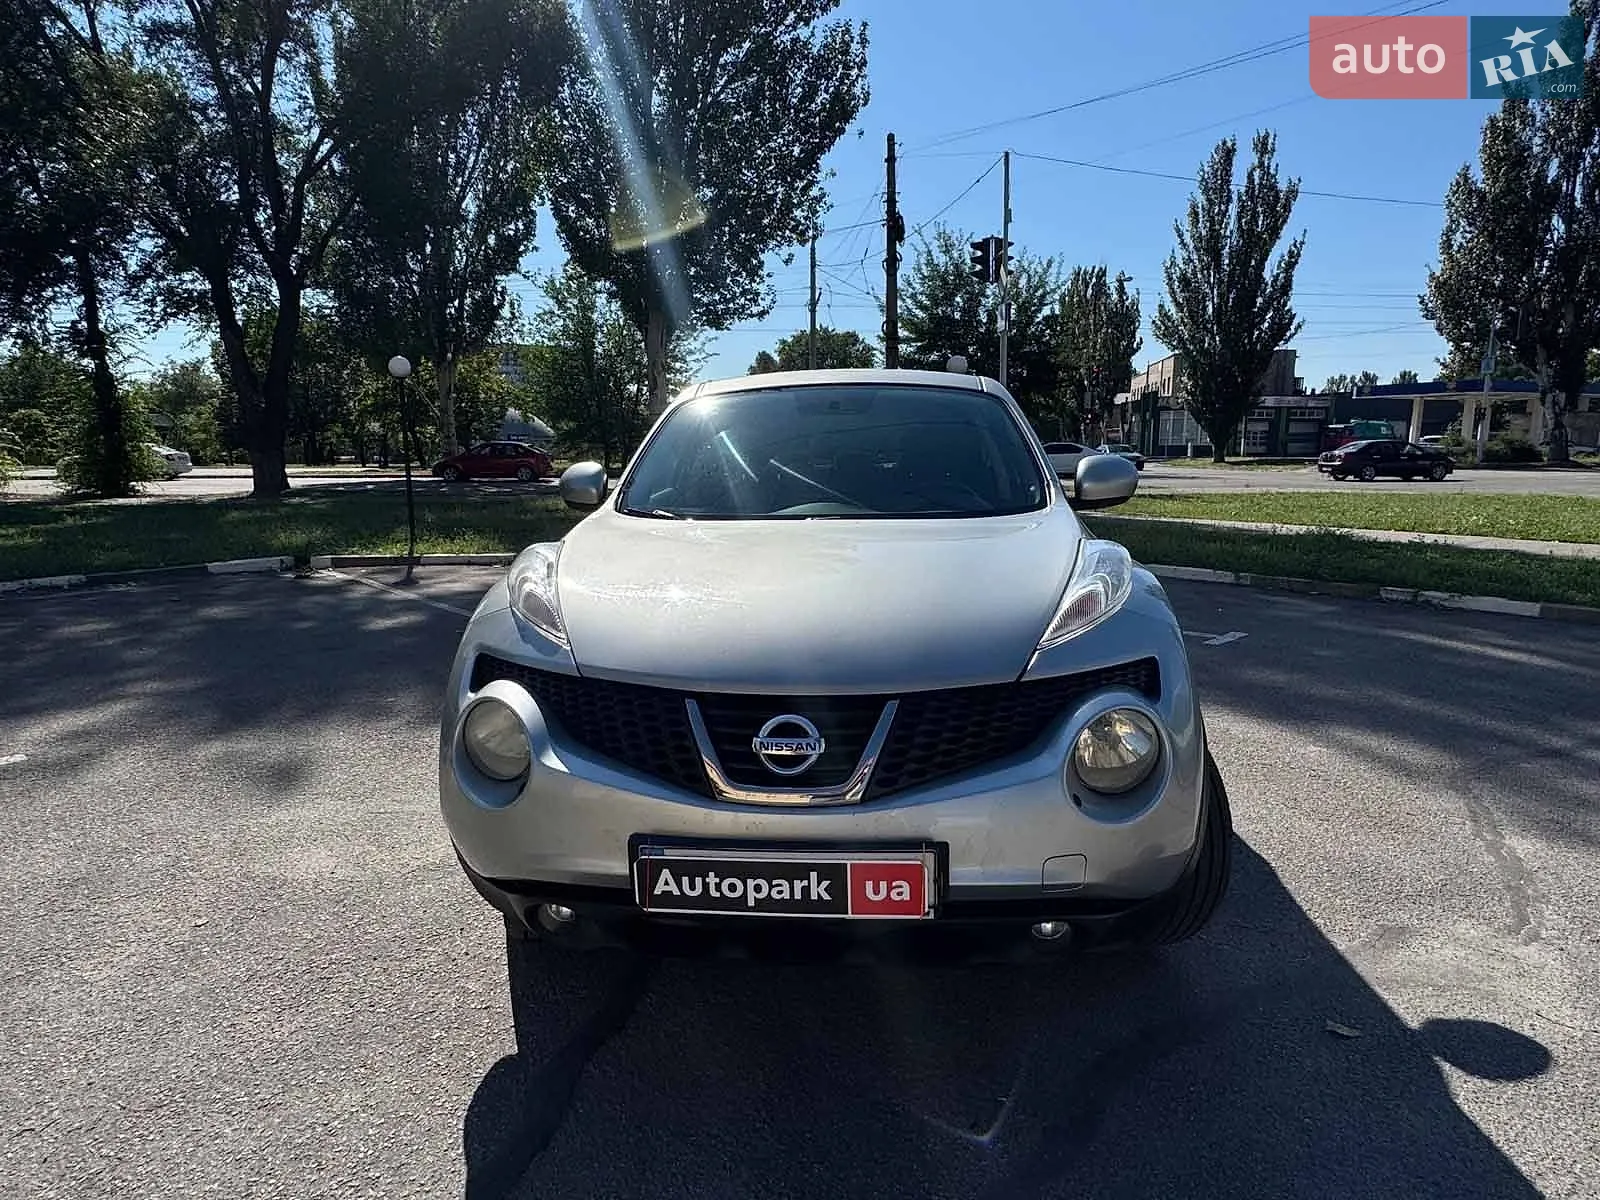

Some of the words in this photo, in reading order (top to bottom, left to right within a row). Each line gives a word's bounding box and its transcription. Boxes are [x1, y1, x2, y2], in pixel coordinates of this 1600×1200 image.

[758, 740, 817, 752] NISSAN
[654, 868, 832, 906] Autopark
[864, 879, 910, 901] ua
